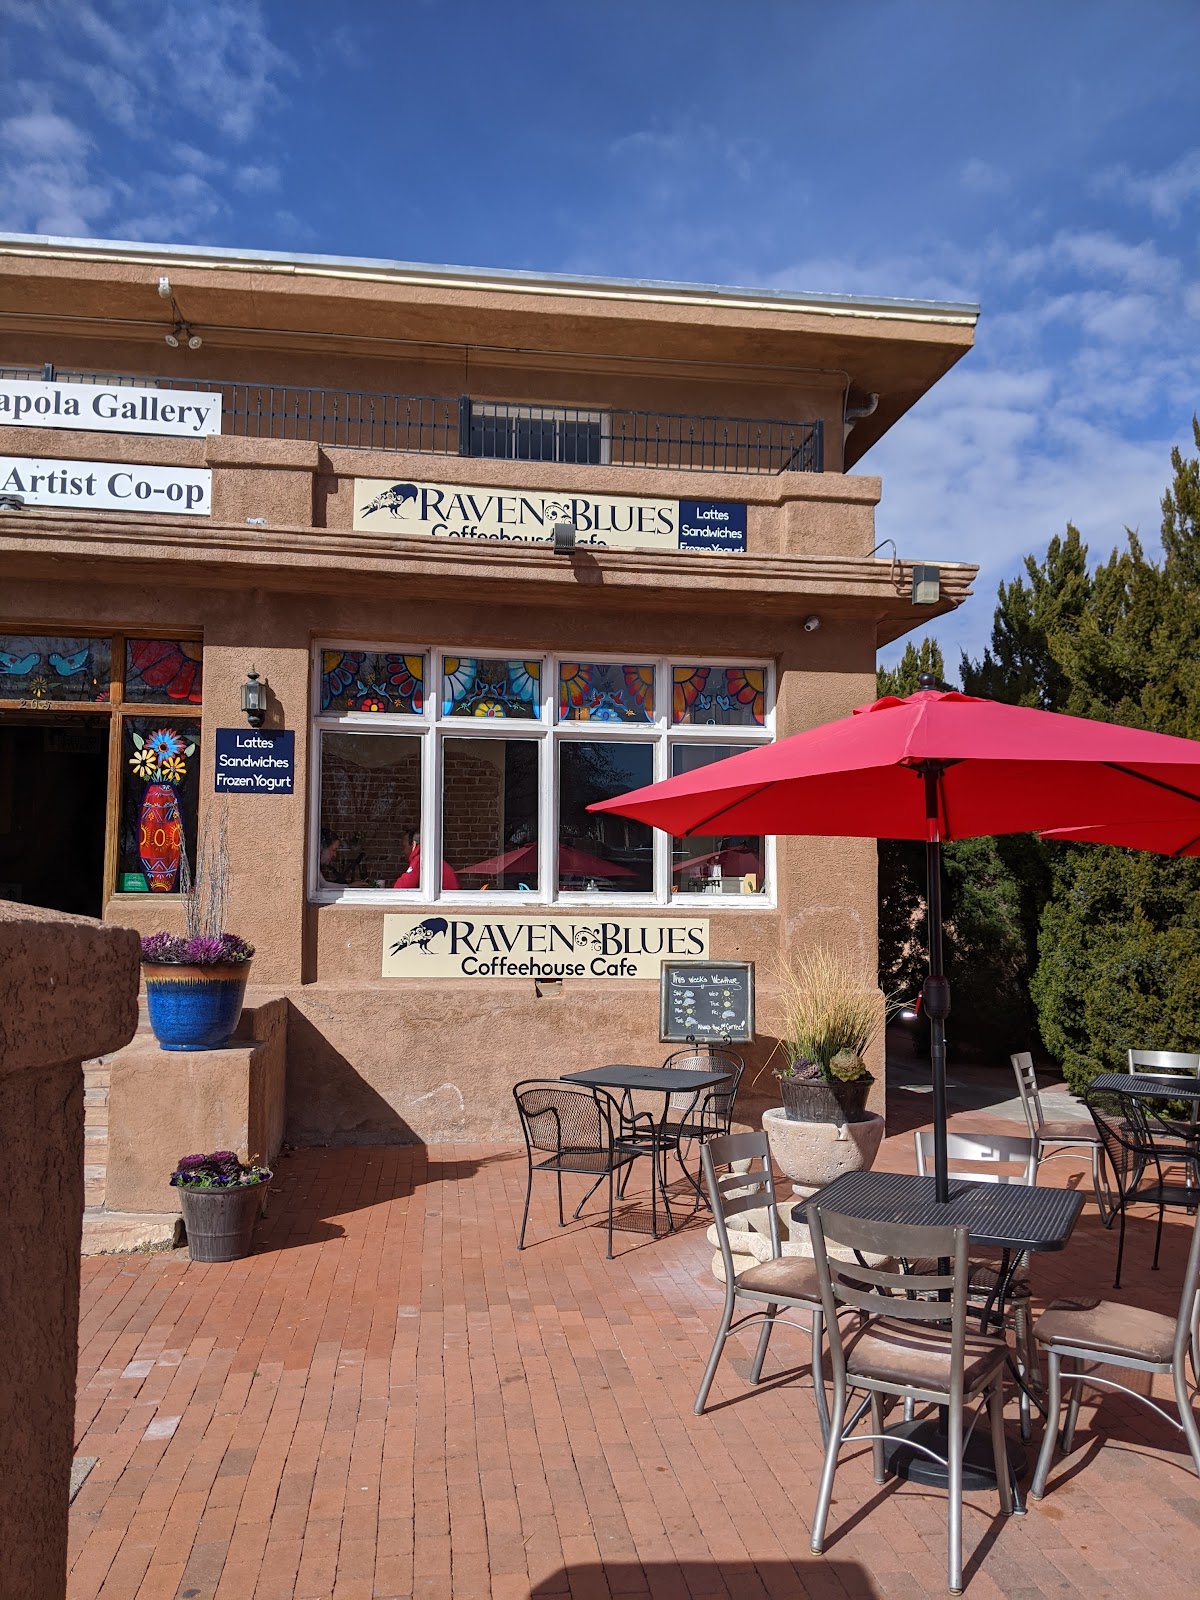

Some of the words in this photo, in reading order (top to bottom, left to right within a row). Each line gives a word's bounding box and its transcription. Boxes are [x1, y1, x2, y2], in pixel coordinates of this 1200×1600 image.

[92, 393, 211, 431] Gallery
[1, 467, 97, 496] Artist
[107, 473, 204, 509] Co-op
[418, 487, 548, 526] RAVEN
[568, 498, 674, 535] BLUES
[696, 507, 730, 520] Lattes
[681, 524, 743, 539] Sandwiches
[236, 735, 274, 749] Lattes
[219, 754, 289, 769] Sandwiches
[216, 773, 254, 787] Frozen
[253, 774, 292, 790] Yogurt
[448, 920, 577, 955] RAVEN
[598, 922, 705, 956] BLUES
[461, 956, 586, 976] Coffeehouse
[590, 957, 638, 977] Cafe
